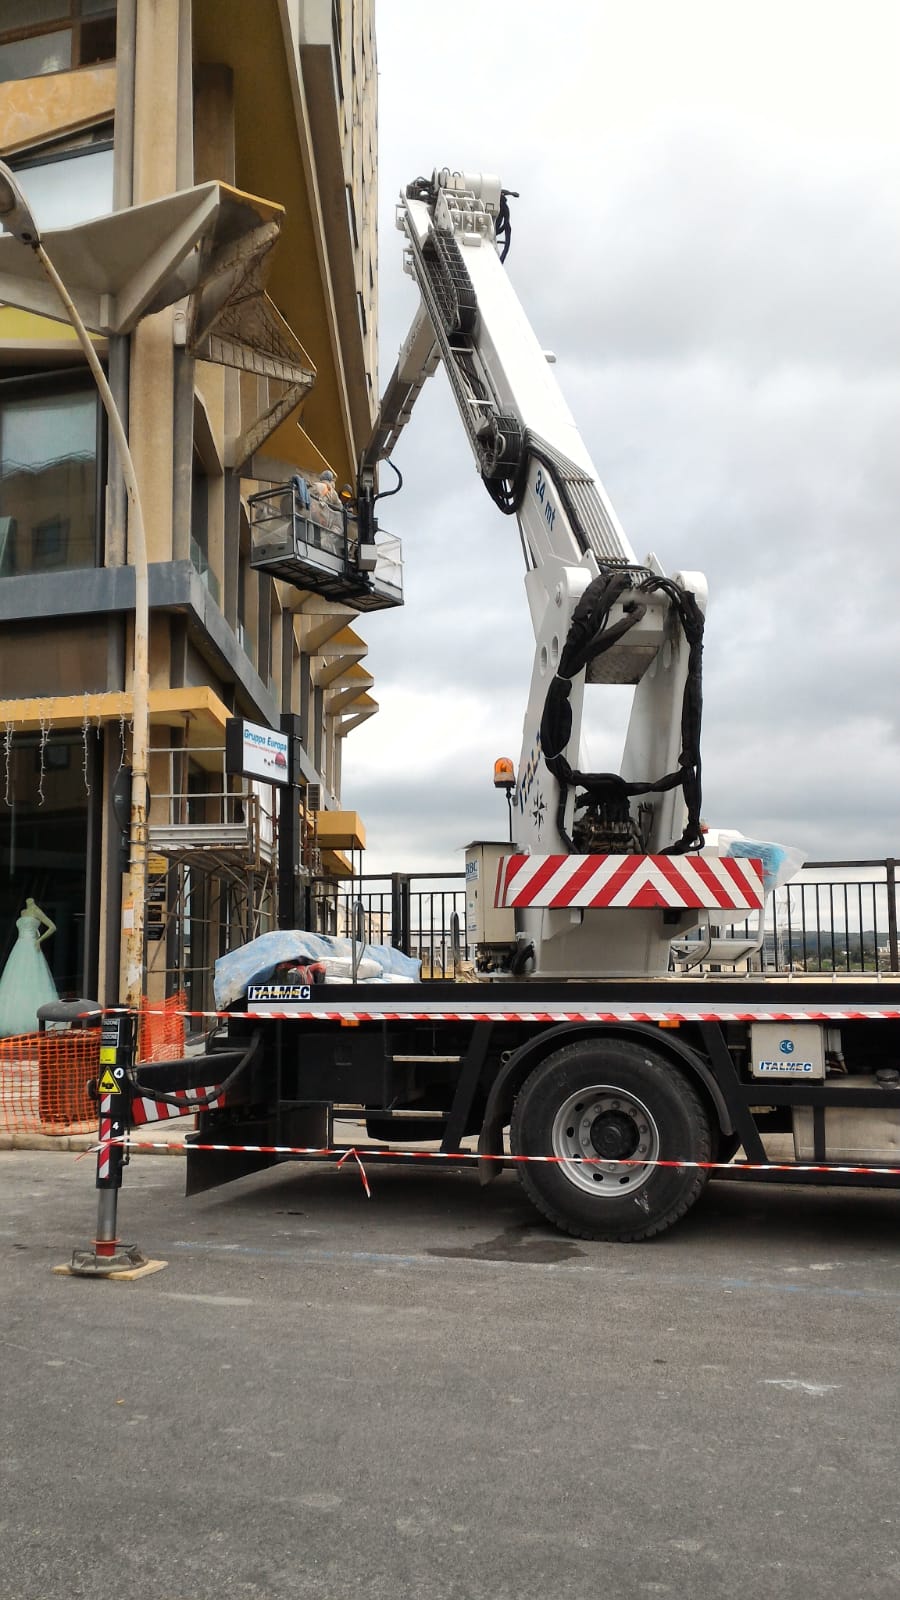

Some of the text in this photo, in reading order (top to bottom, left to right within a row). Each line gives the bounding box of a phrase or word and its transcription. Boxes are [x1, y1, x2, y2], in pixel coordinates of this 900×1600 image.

[536, 470, 556, 531] 34 mt
[244, 729, 266, 745] Gruppo
[267, 736, 287, 752] Europa
[248, 986, 310, 999] ITALMEC
[760, 1061, 812, 1071] ITALMEC
[112, 1121, 119, 1130] 4
